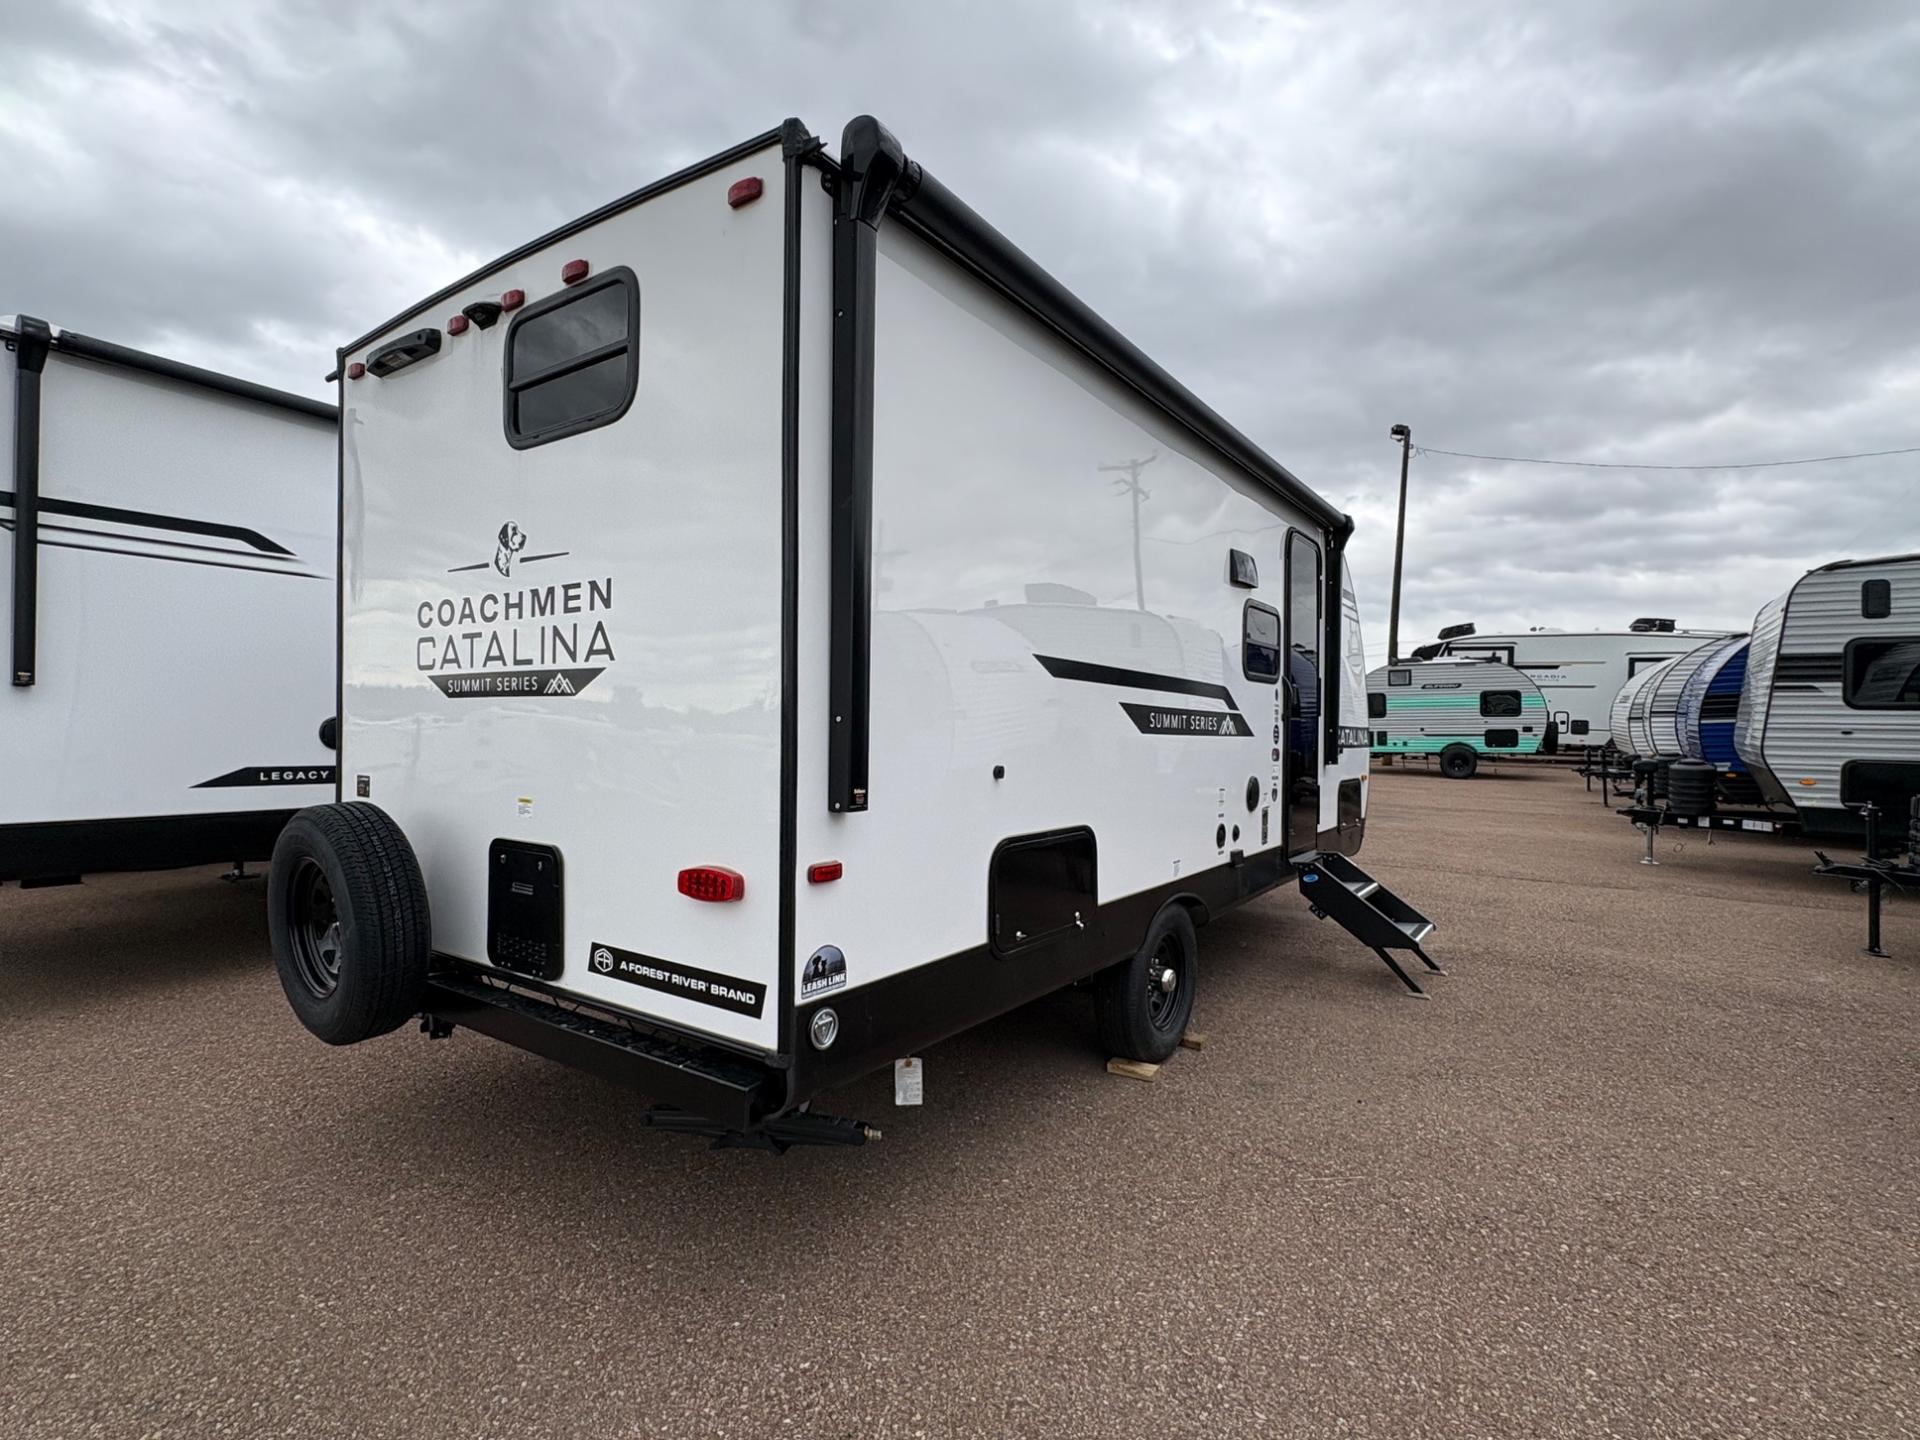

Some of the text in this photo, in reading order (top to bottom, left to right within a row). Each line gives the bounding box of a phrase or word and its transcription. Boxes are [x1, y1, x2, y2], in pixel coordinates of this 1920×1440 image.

[417, 577, 613, 628] COACHMEN
[416, 620, 616, 671] CATALINA
[447, 676, 538, 693] SUMMIT SERIES
[1149, 712, 1217, 731] SUMMIT SERIES
[260, 770, 329, 781] LEGACY
[619, 960, 629, 971] A
[628, 962, 671, 982] FOREST
[710, 983, 756, 1005] BRAND
[802, 972, 846, 994] LEASH LINK
